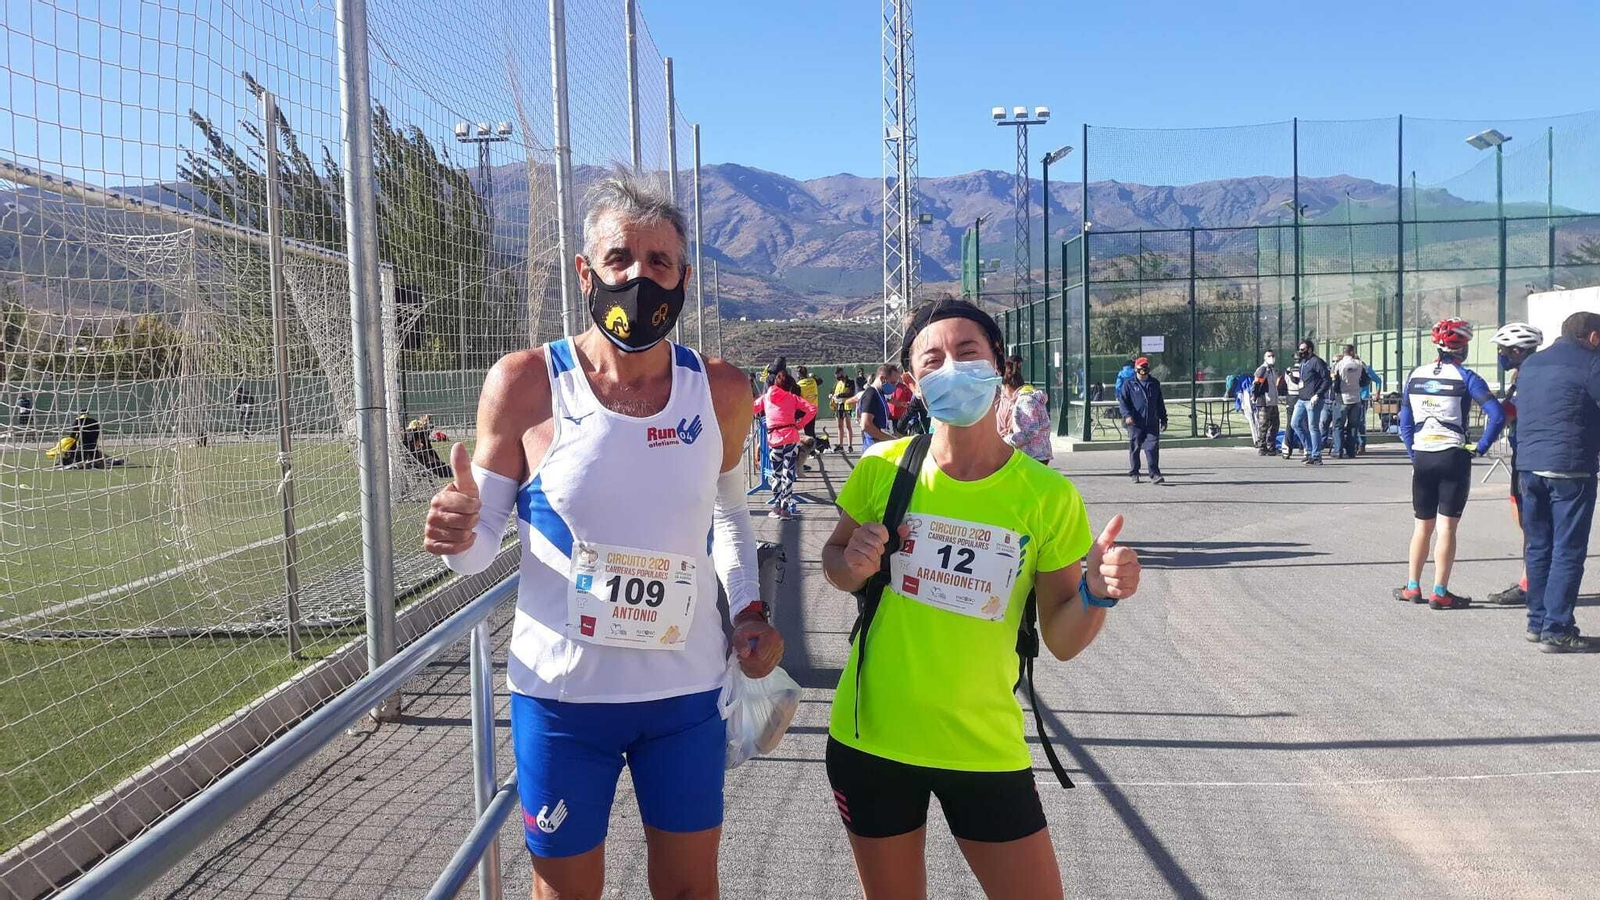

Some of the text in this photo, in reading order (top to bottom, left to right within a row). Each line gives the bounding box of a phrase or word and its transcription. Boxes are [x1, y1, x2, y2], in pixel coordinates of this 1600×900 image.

[647, 427, 693, 442] Run 04
[648, 440, 679, 448] atletismo
[930, 521, 967, 537] CIRCUITO
[928, 532, 956, 545] CARRERAS
[957, 537, 990, 550] POPULARES
[607, 552, 646, 568] CIRCUITO
[937, 544, 976, 575] 12
[605, 565, 635, 576] CARRERAS
[636, 569, 668, 580] POPULARES
[916, 567, 992, 594] ARANGIONETTA
[606, 575, 665, 607] 109
[612, 606, 657, 622] ANTONIO
[539, 820, 555, 830] 04
